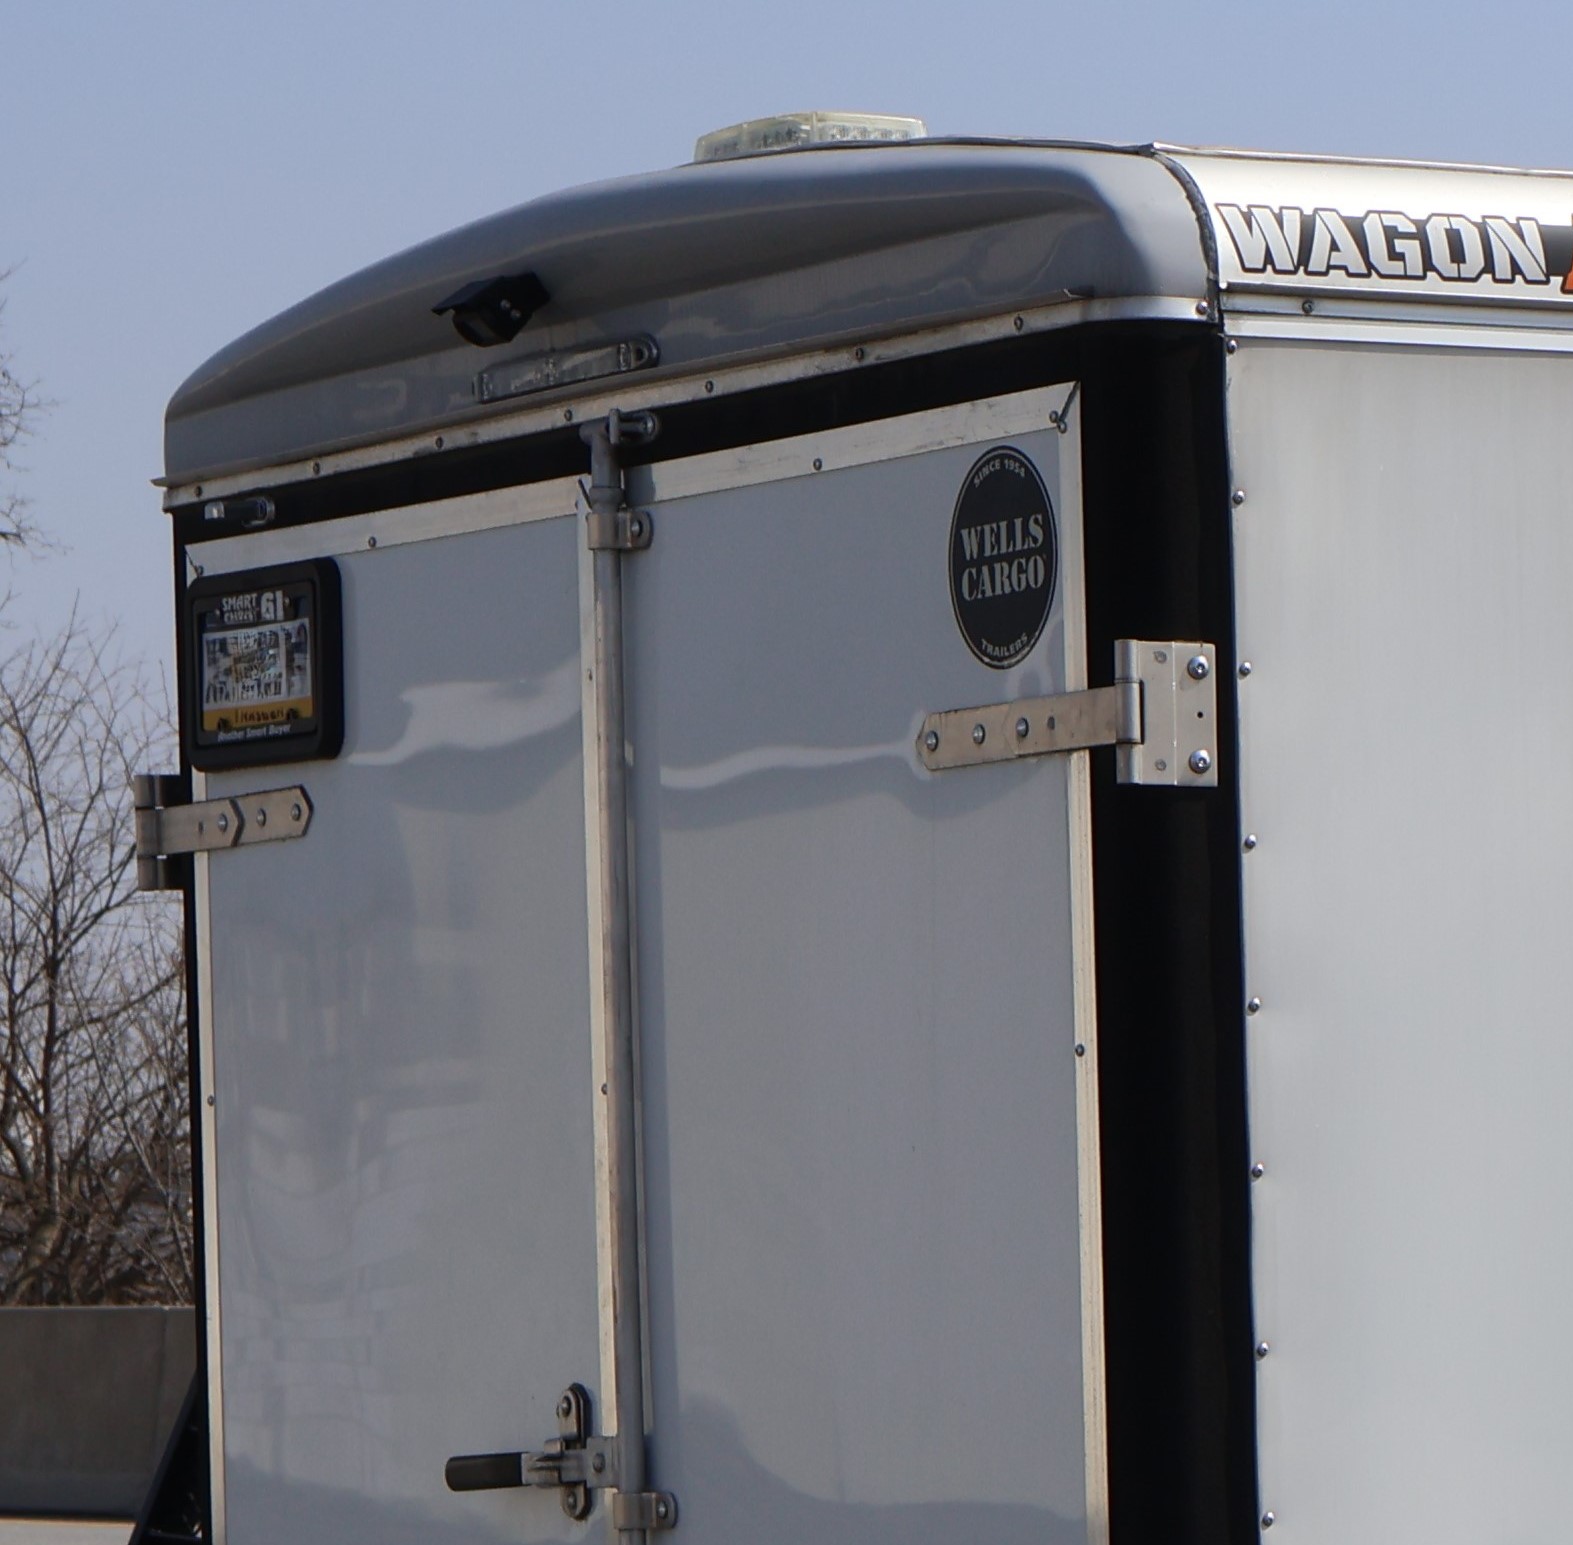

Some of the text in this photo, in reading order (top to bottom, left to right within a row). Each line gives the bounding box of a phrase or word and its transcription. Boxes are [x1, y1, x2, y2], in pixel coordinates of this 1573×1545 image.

[1214, 203, 1549, 285] WAGON
[973, 459, 1002, 489] SINCE
[960, 513, 1045, 561] WELLS
[961, 554, 1046, 602] CARGO
[981, 632, 1028, 658] TRAILERS
